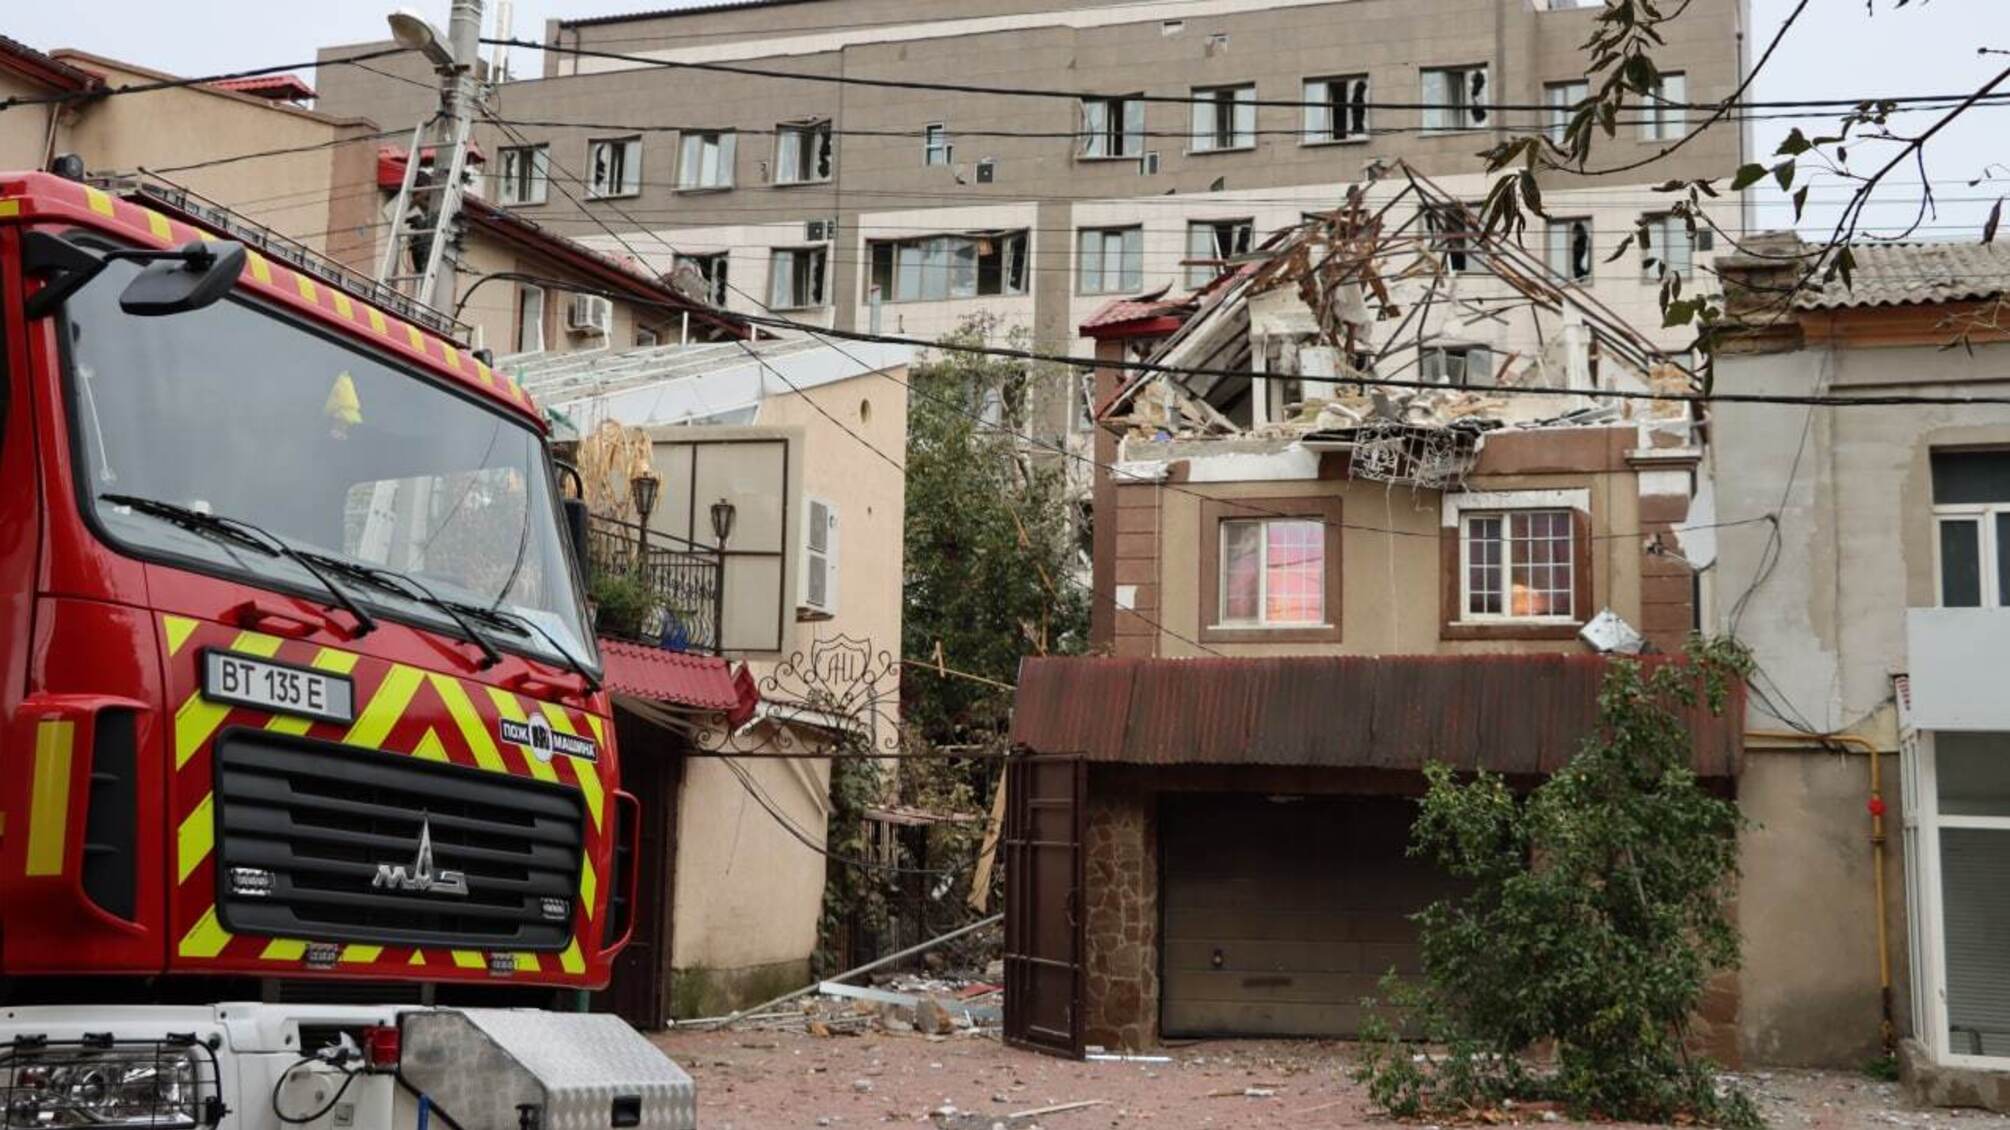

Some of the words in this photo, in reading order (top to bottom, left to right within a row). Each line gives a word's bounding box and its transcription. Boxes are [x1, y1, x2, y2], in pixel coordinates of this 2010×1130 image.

[222, 659, 256, 695] BT
[265, 669, 301, 704] 135
[307, 677, 323, 710] E
